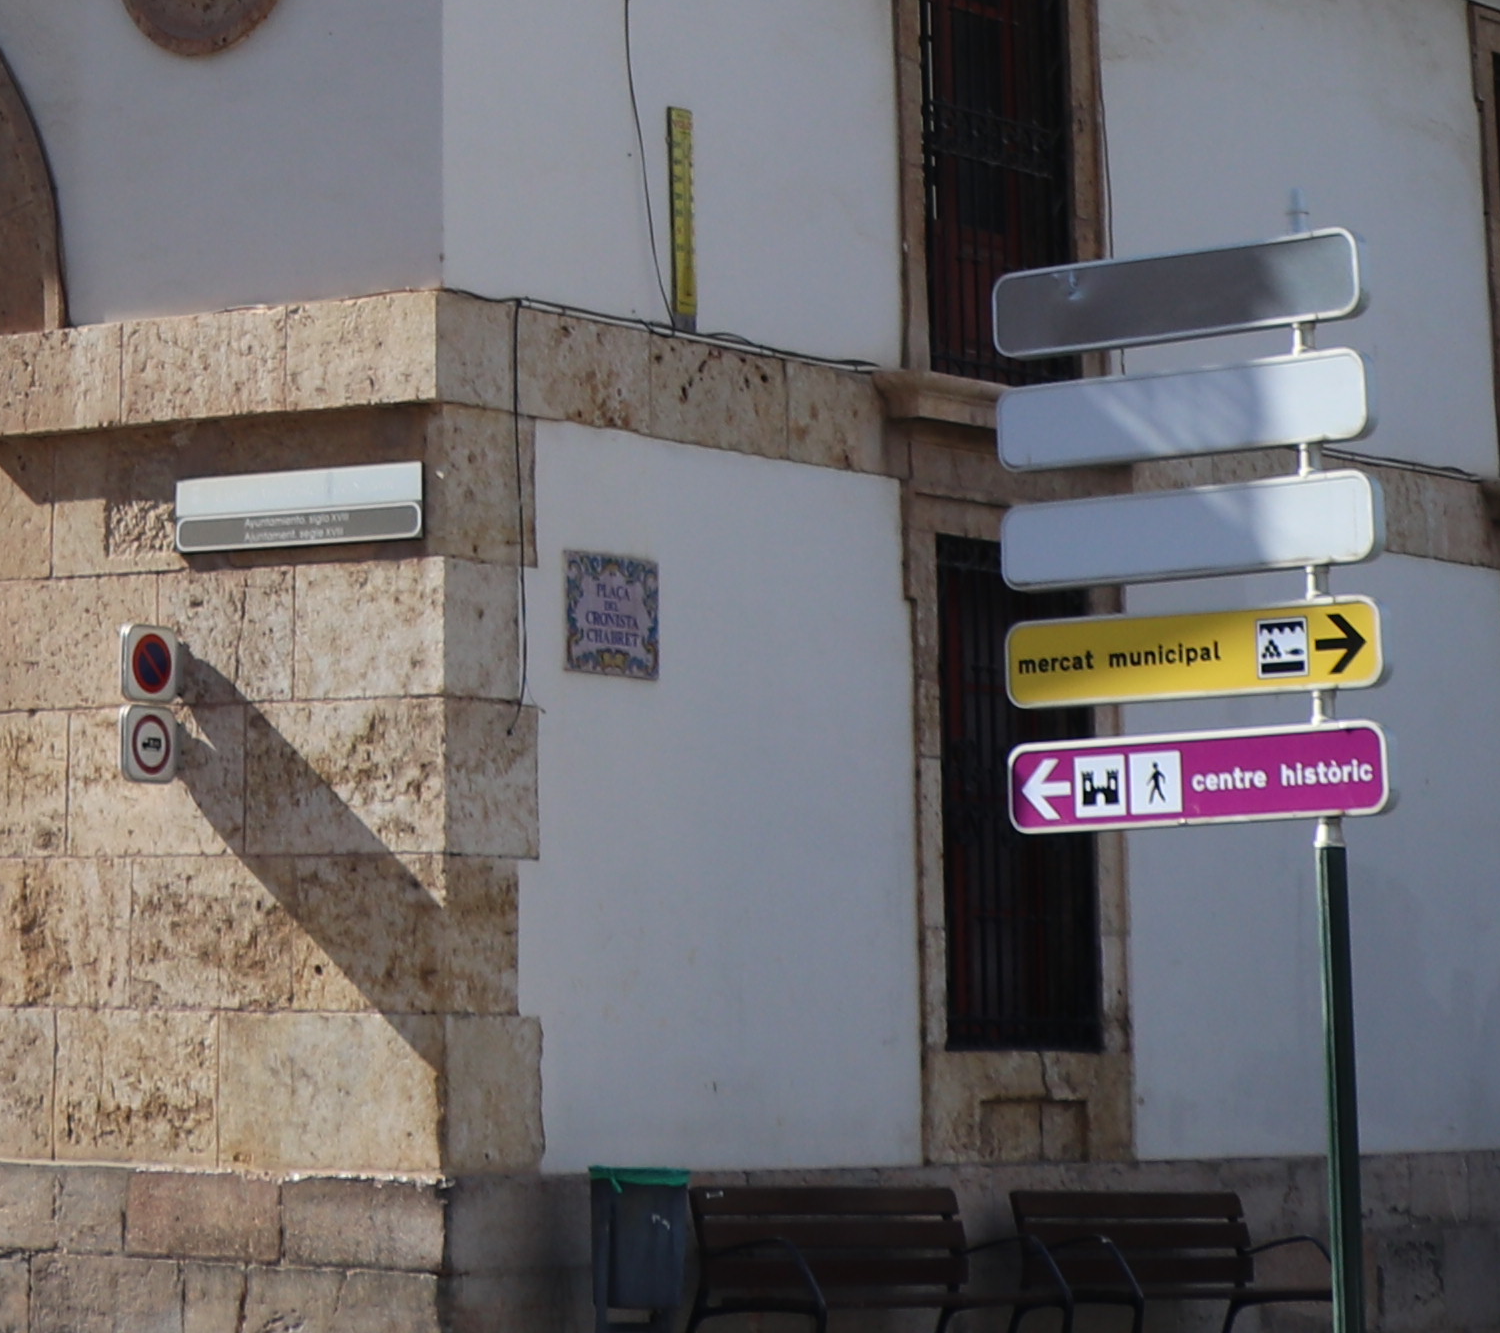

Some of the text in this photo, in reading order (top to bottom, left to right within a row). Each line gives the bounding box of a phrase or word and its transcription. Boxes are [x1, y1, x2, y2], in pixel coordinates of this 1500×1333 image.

[596, 583, 630, 602] PLAÇA
[604, 600, 618, 612] DEL
[585, 610, 639, 631] CRONISTA
[586, 628, 640, 648] CHABRET
[1018, 639, 1222, 675] mercat municipal
[1191, 758, 1374, 792] centre històric
